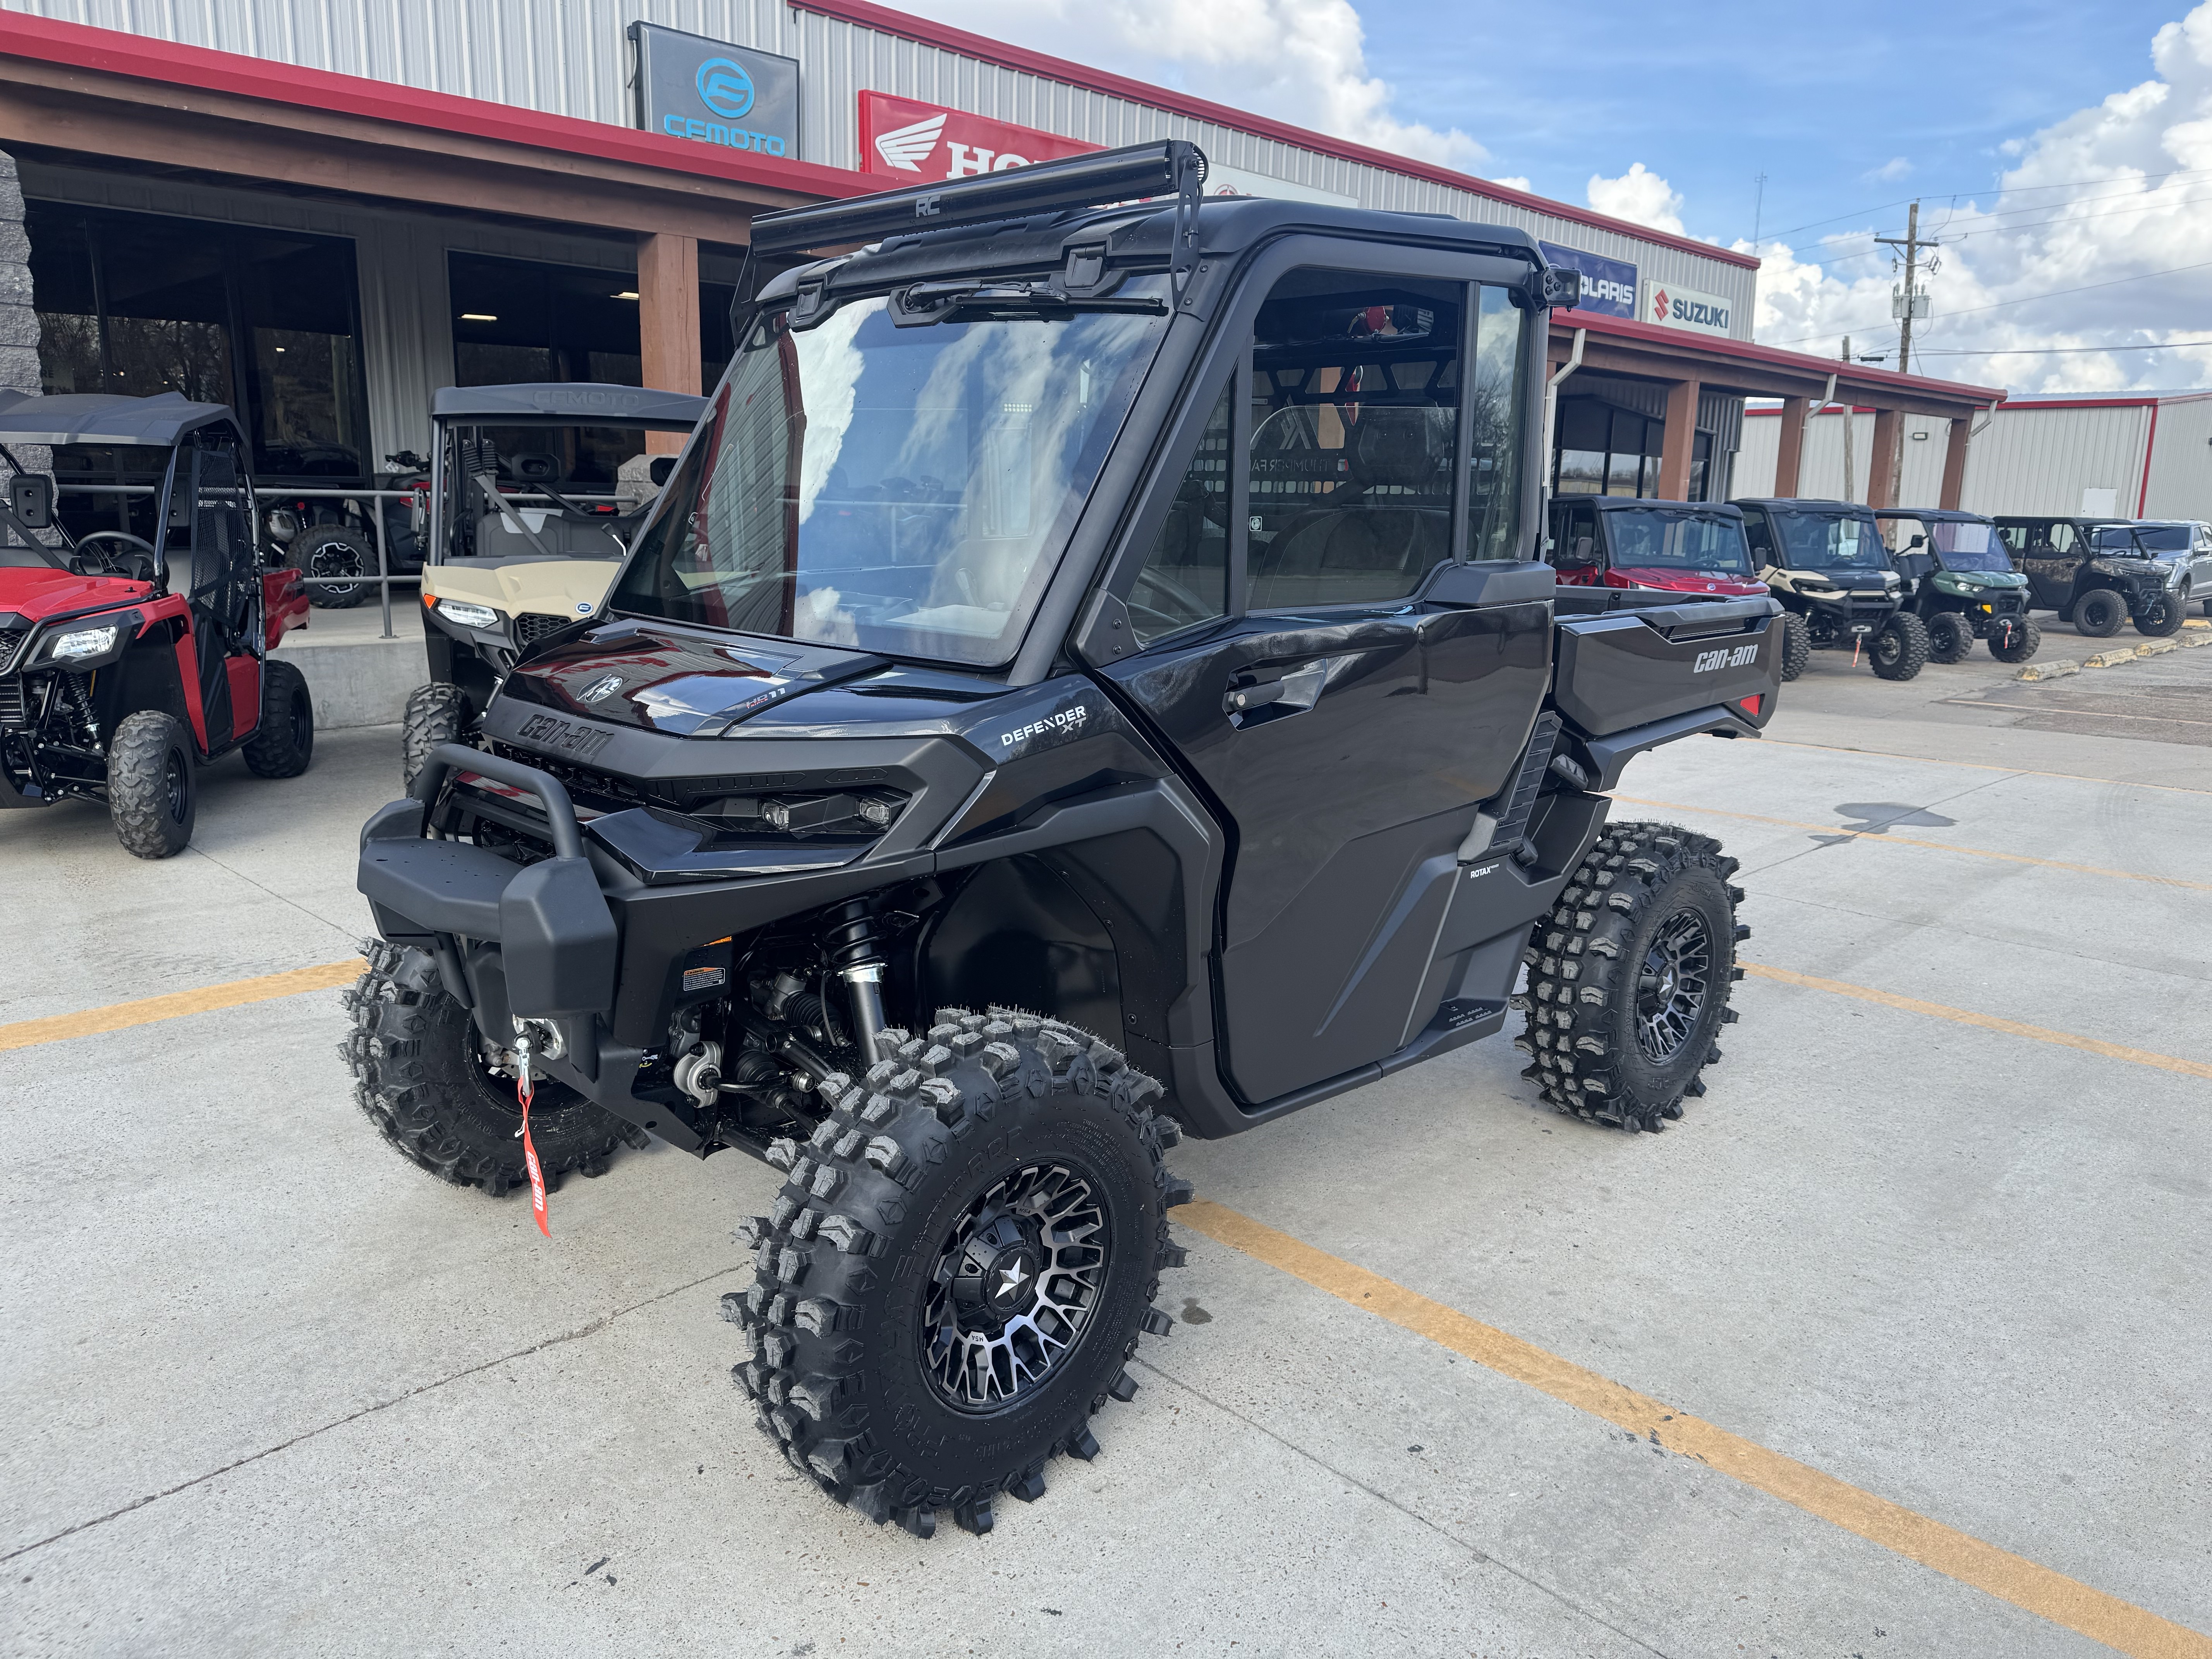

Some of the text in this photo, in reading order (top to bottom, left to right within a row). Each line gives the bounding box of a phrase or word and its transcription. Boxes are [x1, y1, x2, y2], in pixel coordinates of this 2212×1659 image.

[664, 114, 785, 157] CFMOTO
[915, 195, 941, 218] RC
[1581, 275, 1633, 304] OLARIS
[1673, 298, 1729, 329] SUZUKI
[533, 391, 639, 406] CFMOTO
[1693, 644, 1759, 673] can-am
[516, 714, 615, 756] can-am
[1001, 705, 1086, 746] DEFENDER
[1061, 716, 1087, 735] XT
[1470, 866, 1491, 879] ROTAX
[527, 1150, 544, 1211] can-am
